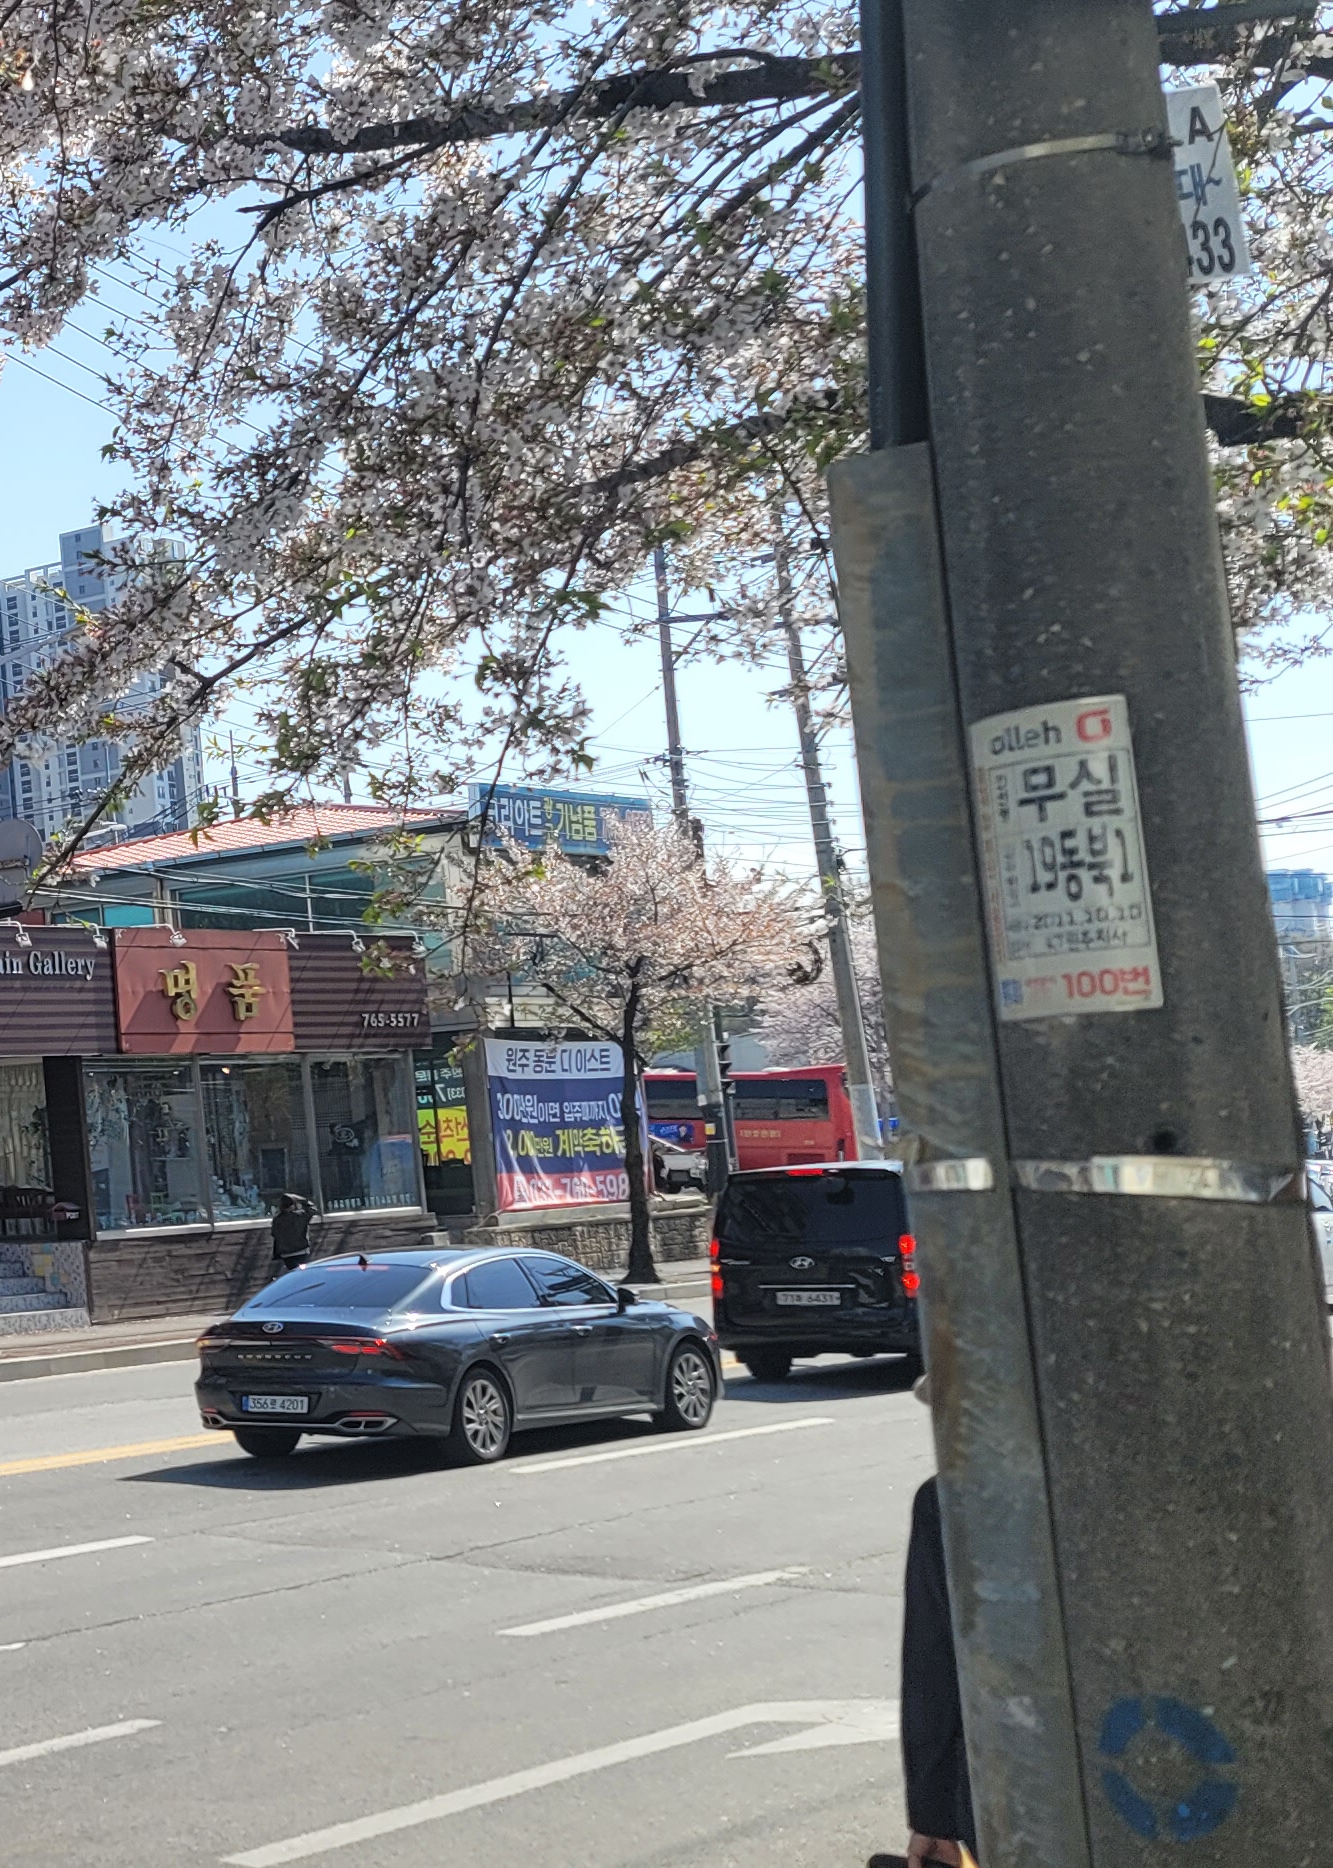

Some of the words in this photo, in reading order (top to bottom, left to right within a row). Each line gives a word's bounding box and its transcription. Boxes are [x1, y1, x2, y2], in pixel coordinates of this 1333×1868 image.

[1189, 106, 1215, 145] A
[1188, 217, 1236, 276] 33
[991, 719, 1063, 756] olleh
[1018, 754, 1124, 823] 무실
[555, 802, 597, 842] 기념품
[29, 950, 96, 981] Gallery
[1061, 965, 1153, 1001] 100번
[361, 1012, 420, 1028] 765-5577
[505, 1047, 531, 1074] 원주
[560, 1050, 573, 1074] 디
[576, 1048, 611, 1074] 이스트
[280, 1399, 305, 1411] 4201
